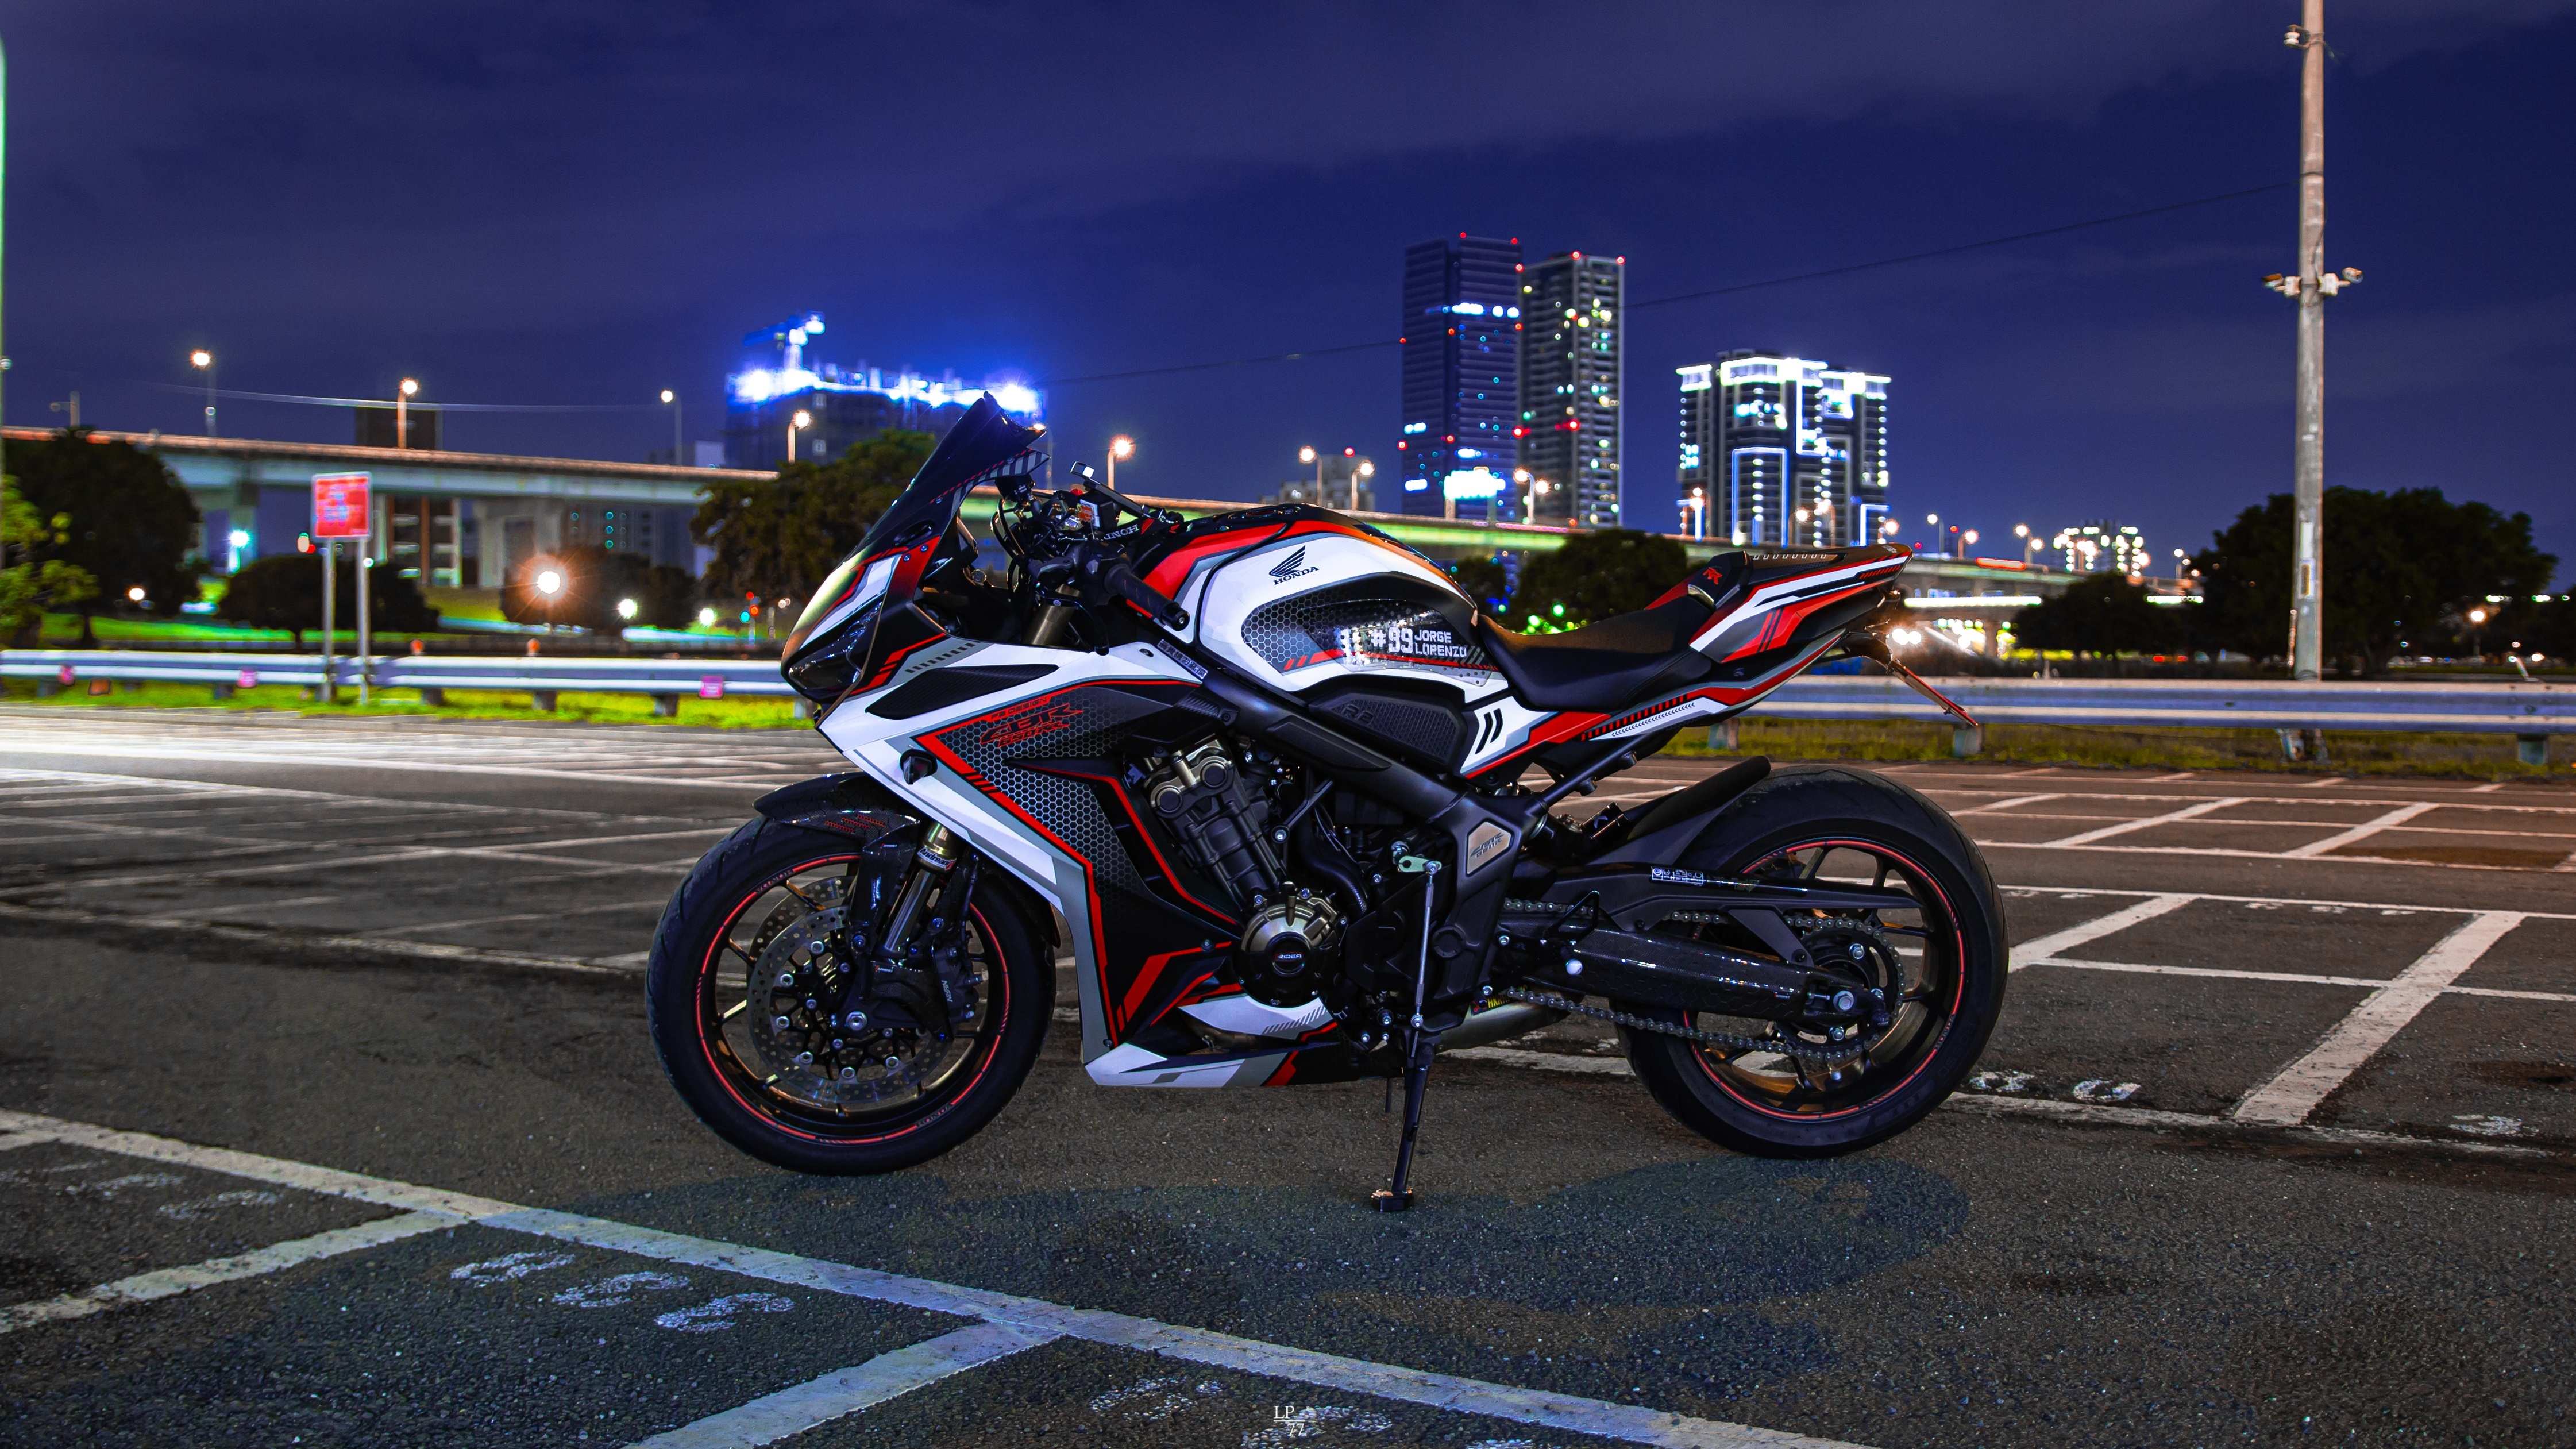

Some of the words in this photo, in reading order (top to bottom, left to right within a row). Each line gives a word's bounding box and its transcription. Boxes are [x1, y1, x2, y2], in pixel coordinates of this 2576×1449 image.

[1104, 524, 1139, 540] HOND
[1273, 566, 1320, 585] HONDA
[1371, 627, 1413, 653] #99
[1414, 629, 1452, 643] JORGE
[1415, 642, 1467, 658] LORENZO
[1008, 697, 1047, 714] DESIGN
[980, 703, 1085, 745] CBR
